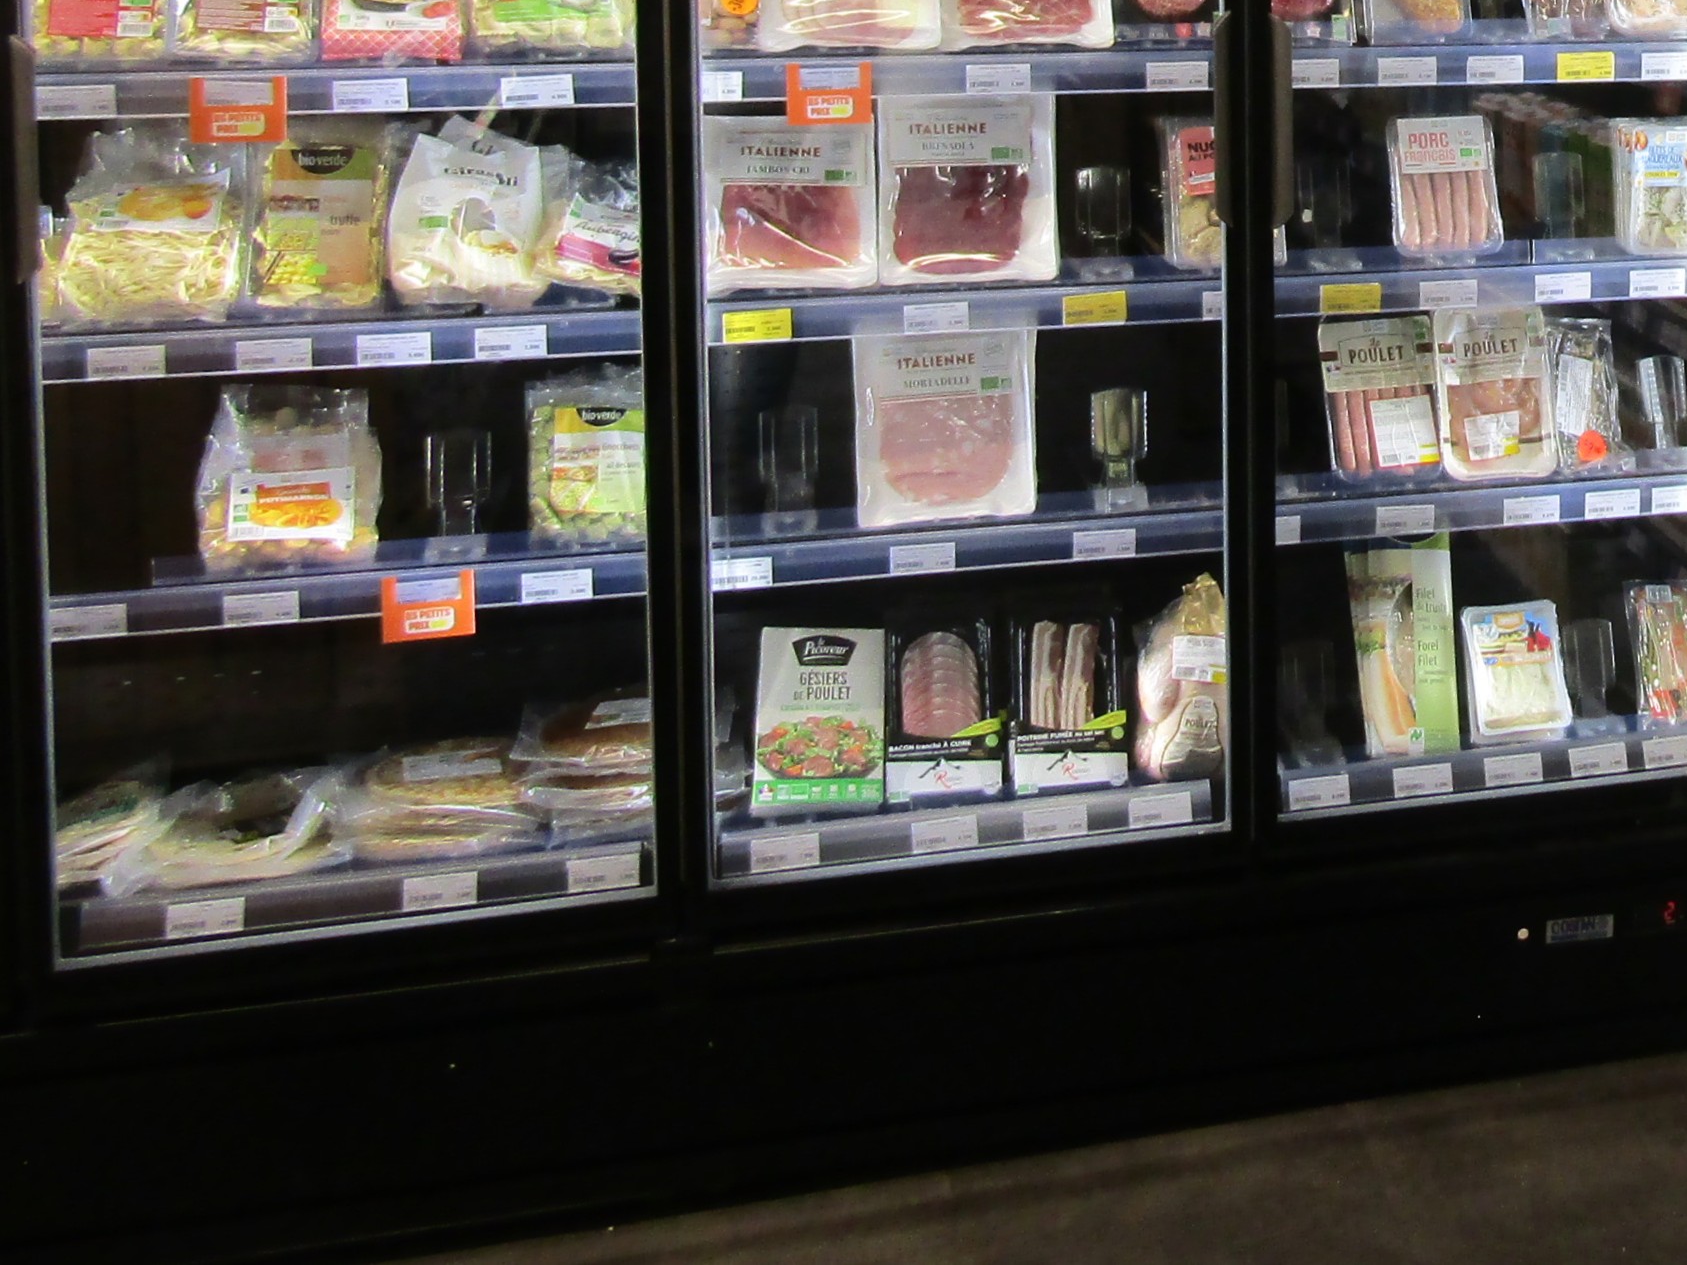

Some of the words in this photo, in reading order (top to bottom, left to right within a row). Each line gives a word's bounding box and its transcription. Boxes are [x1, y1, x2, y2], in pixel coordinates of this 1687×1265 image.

[909, 122, 987, 135] ITALIENNE
[1408, 132, 1449, 148] PORC
[740, 146, 822, 158] ITALIENNE
[1348, 345, 1404, 365] POULET
[1463, 338, 1519, 358] POULET
[897, 351, 976, 371] ITALIENNE
[1417, 654, 1438, 667] Filet
[800, 669, 848, 686] GÉSIERS
[805, 684, 852, 701] POULET
[889, 743, 915, 753] BACON
